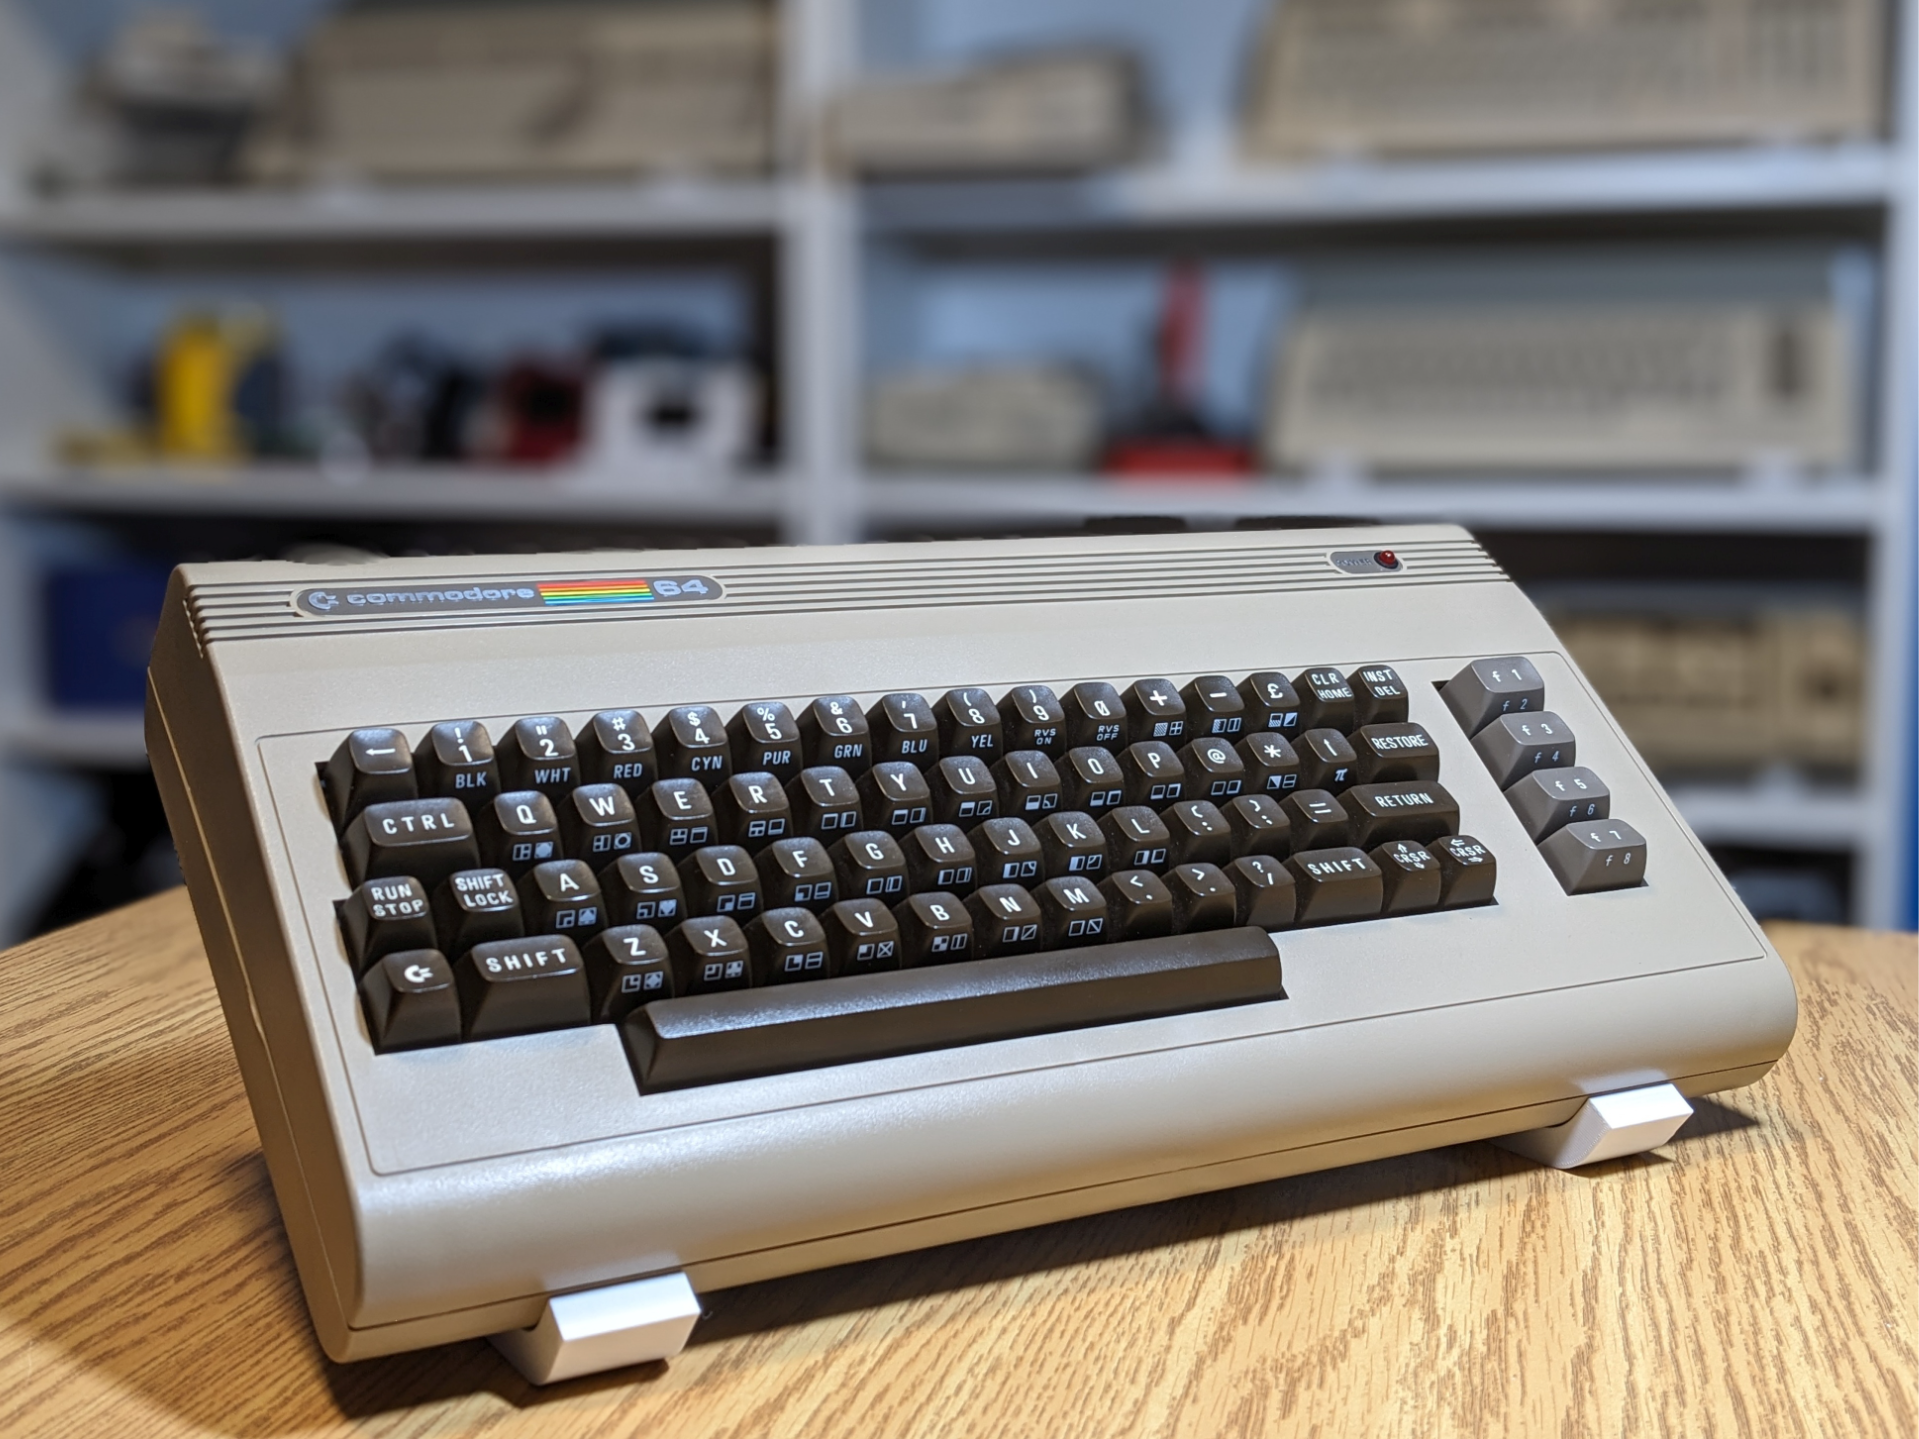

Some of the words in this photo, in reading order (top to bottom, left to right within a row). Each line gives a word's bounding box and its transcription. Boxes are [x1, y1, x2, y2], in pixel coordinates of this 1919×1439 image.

[346, 586, 535, 605] commodore
[652, 579, 709, 596] 64
[1312, 673, 1339, 685] CLR
[1363, 670, 1393, 682] INST
[1317, 687, 1352, 699] HOME
[1375, 686, 1400, 696] DEL
[968, 709, 985, 724] 8
[1033, 705, 1049, 720] 9
[836, 718, 852, 734] 6
[904, 713, 917, 729] 7
[1098, 725, 1119, 733] RVS
[695, 728, 710, 744] 4
[765, 723, 782, 740] 5
[1034, 728, 1056, 737] RVS
[1097, 733, 1118, 741] OFF
[540, 739, 559, 757] 2
[618, 733, 635, 751] 3
[902, 739, 928, 754] BLU
[971, 734, 993, 748] YEL
[1036, 737, 1052, 745] ON
[1371, 734, 1428, 750] RESTORE
[458, 745, 472, 762] 1
[763, 751, 791, 765] PUR
[834, 744, 862, 758] GRN
[691, 756, 723, 771] CYN
[1148, 753, 1161, 769] P
[535, 768, 571, 783] WHT
[613, 763, 643, 778] RED
[958, 768, 975, 785] U
[1027, 762, 1038, 779] I
[455, 772, 487, 789] BLK
[819, 779, 835, 797] T
[891, 773, 906, 791] Y
[673, 791, 691, 810] E
[748, 785, 767, 804] R
[1375, 793, 1433, 808] RETURN
[516, 805, 536, 824] Q
[589, 796, 616, 817] W
[382, 813, 454, 834] CTRL
[1066, 823, 1086, 839] K
[1131, 819, 1150, 833] L
[935, 837, 955, 854] H
[1008, 829, 1021, 846] J
[793, 850, 808, 868] F
[865, 843, 884, 860] G
[1393, 851, 1430, 863] CRSR
[1450, 845, 1485, 857] CRSR
[639, 866, 658, 884] S
[716, 858, 736, 876] D
[1307, 858, 1367, 876] SHIFT
[455, 873, 504, 891] SHIFT
[560, 873, 580, 892] A
[371, 884, 412, 900] RUN
[463, 890, 513, 907] LOCK
[1064, 888, 1090, 903] M
[373, 899, 423, 917] STOP
[930, 905, 950, 921] B
[999, 897, 1022, 913] N
[855, 911, 874, 928] V
[784, 920, 804, 938] C
[704, 929, 727, 947] X
[623, 938, 646, 956] Z
[486, 948, 566, 973] SHIFT
